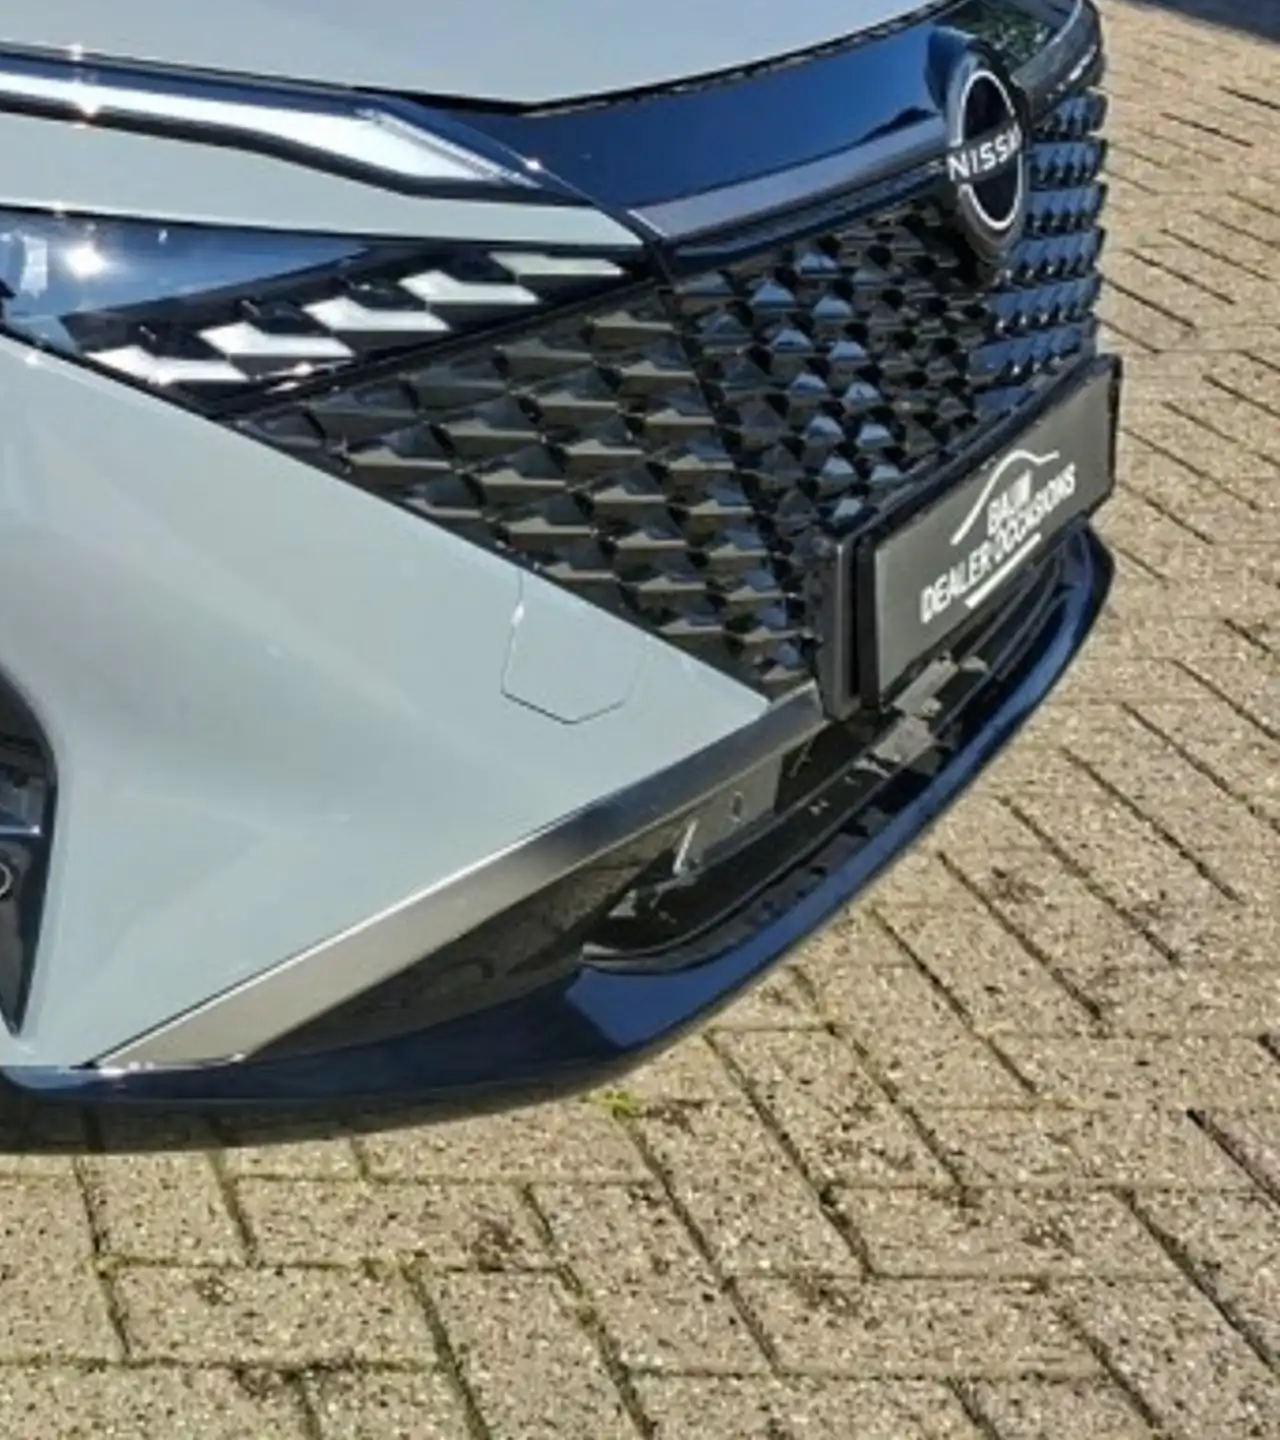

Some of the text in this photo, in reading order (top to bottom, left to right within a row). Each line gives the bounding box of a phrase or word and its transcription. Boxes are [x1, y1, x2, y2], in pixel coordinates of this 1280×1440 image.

[947, 121, 1022, 181] NISSA
[921, 462, 1076, 624] DEALER OCCASIONS
